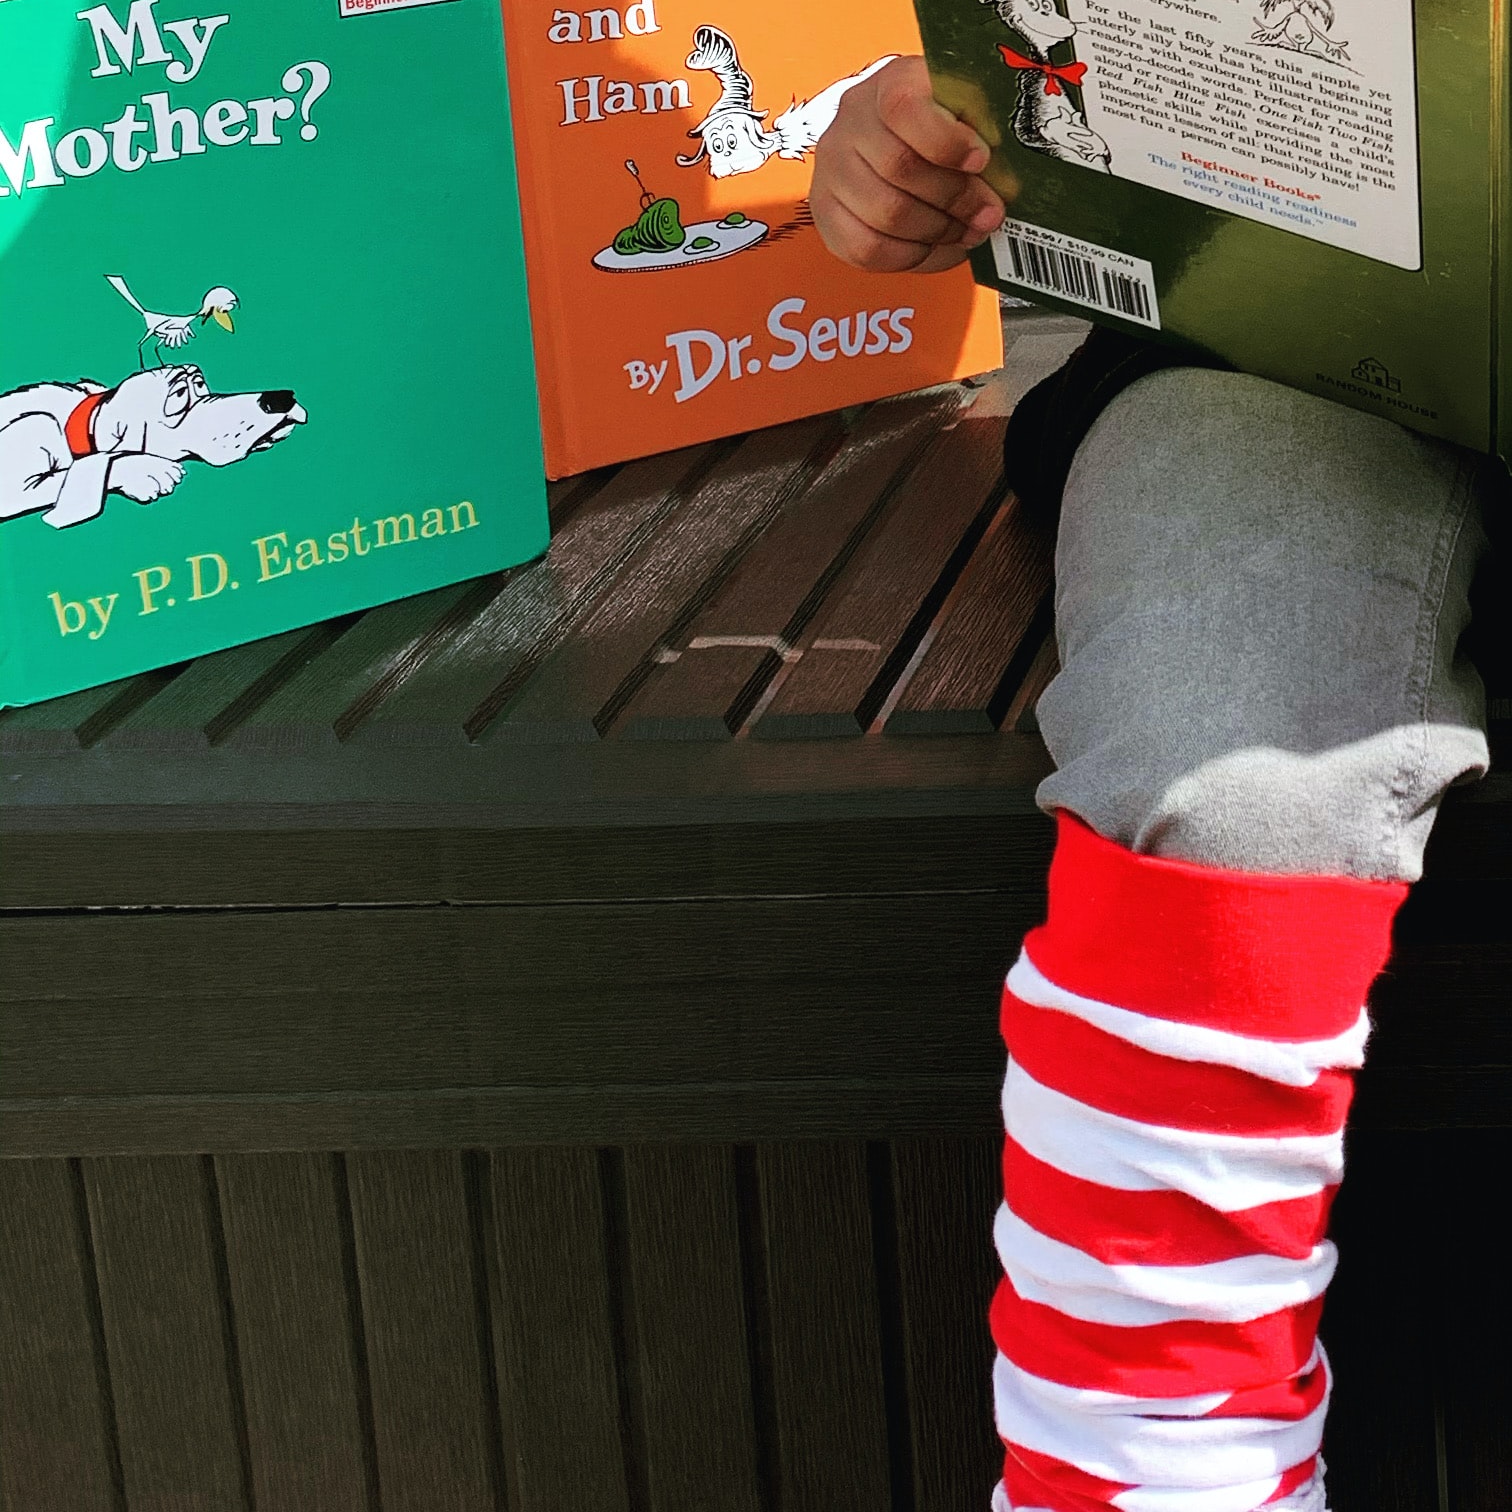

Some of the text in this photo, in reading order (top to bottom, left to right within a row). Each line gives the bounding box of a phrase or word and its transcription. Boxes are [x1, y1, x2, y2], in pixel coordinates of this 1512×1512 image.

[556, 73, 694, 128] Ham
[1085, 0, 1392, 102] For the last fifty this simple yet
[1087, 15, 1393, 117] utterly silly book has beguiled beginning
[1089, 28, 1393, 128] readers with exuberant illustrations and
[1091, 41, 1394, 143] easy-to-decode Perfect for reading
[0, 60, 331, 199] Mother?
[1094, 54, 1393, 154] aloud or reading One Fish Two Fish
[1096, 65, 1321, 143] Red Fish Blue Fish exercises
[1098, 79, 1396, 179] phonetic skills while providing the most
[1099, 91, 1396, 191] important lesson that reading the
[1102, 104, 1317, 179] most fun person can possibly
[1180, 151, 1259, 183] Beginner
[1181, 166, 1280, 205] right reading
[1107, 252, 1135, 268] CAN
[622, 297, 915, 404] By Dr. Seuss
[46, 591, 119, 640] by
[250, 499, 480, 584] Eastman
